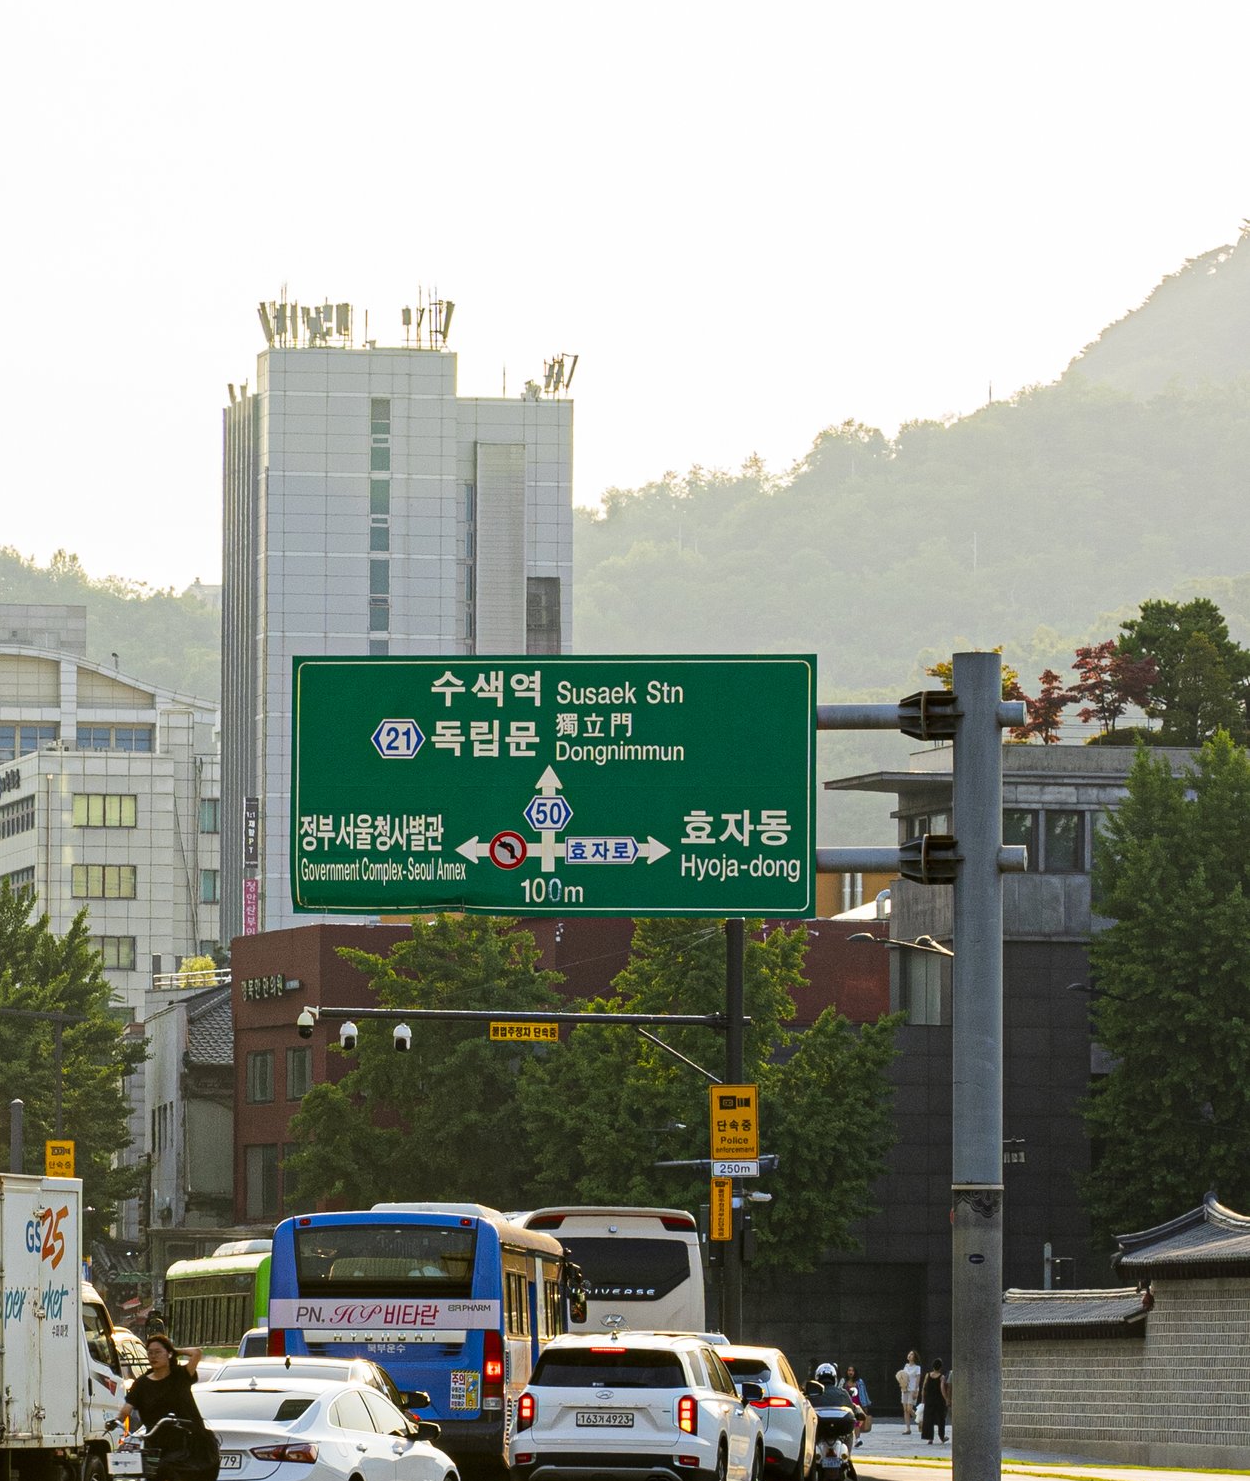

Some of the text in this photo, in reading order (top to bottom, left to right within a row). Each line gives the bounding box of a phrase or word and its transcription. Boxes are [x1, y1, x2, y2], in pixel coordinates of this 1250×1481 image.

[431, 670, 541, 707] 수색역
[556, 680, 684, 705] Susaek Stn
[555, 712, 633, 738] 獨立門
[385, 727, 412, 751] 21
[431, 719, 540, 757] 독립문
[555, 740, 685, 766] Dongnimmun
[535, 802, 563, 825] 50
[299, 813, 445, 852] 정부서울청사별관
[680, 809, 792, 847] 효자동
[569, 841, 632, 860] 효자로
[301, 857, 360, 881] Government
[436, 857, 467, 881] Annex
[680, 853, 801, 883] Hyoja-dong
[520, 878, 584, 903] 100m
[533, 1027, 557, 1038] 단속중
[716, 1119, 752, 1132] 단속중
[720, 1136, 749, 1144] Police
[719, 1164, 751, 1174] 250m
[383, 1304, 440, 1326] 비타란
[462, 1304, 491, 1312] PHARM
[333, 1332, 436, 1341] HYUNDAI
